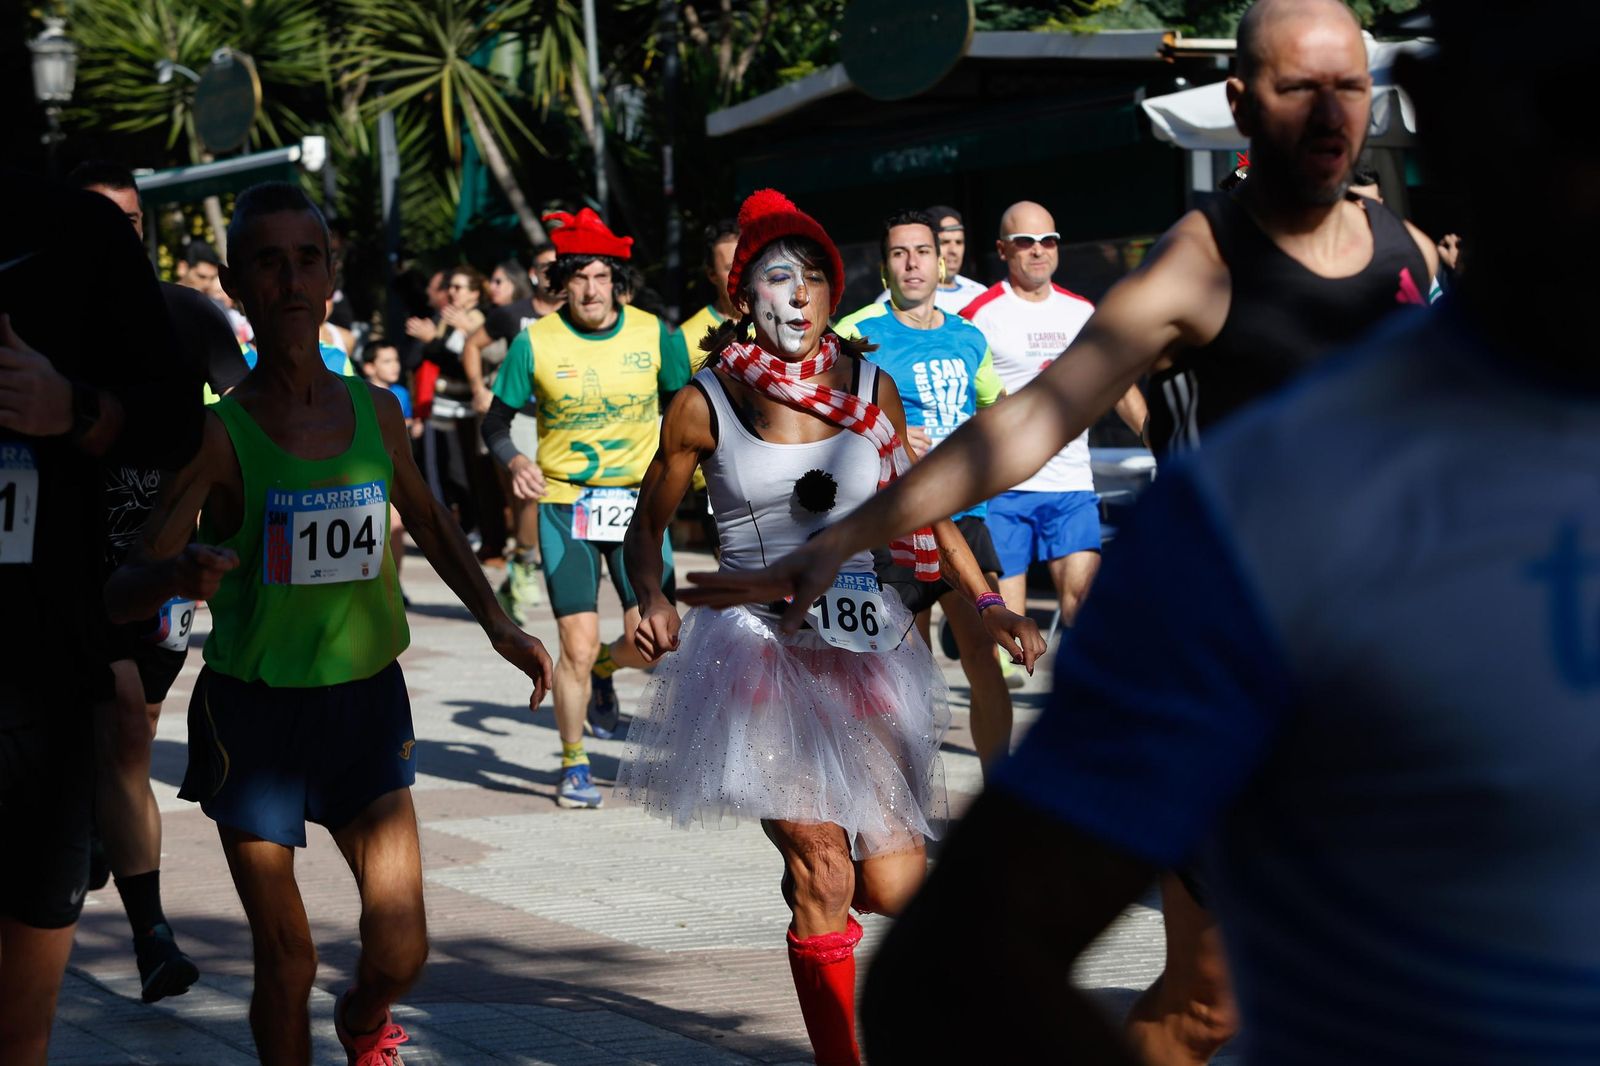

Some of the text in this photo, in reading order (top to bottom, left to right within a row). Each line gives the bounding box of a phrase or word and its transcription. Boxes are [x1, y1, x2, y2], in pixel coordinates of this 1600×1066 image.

[930, 358, 968, 380] SAN
[274, 485, 383, 506] III CARRERA
[591, 504, 635, 527] 122
[299, 515, 377, 561] 104
[812, 594, 879, 637] 186
